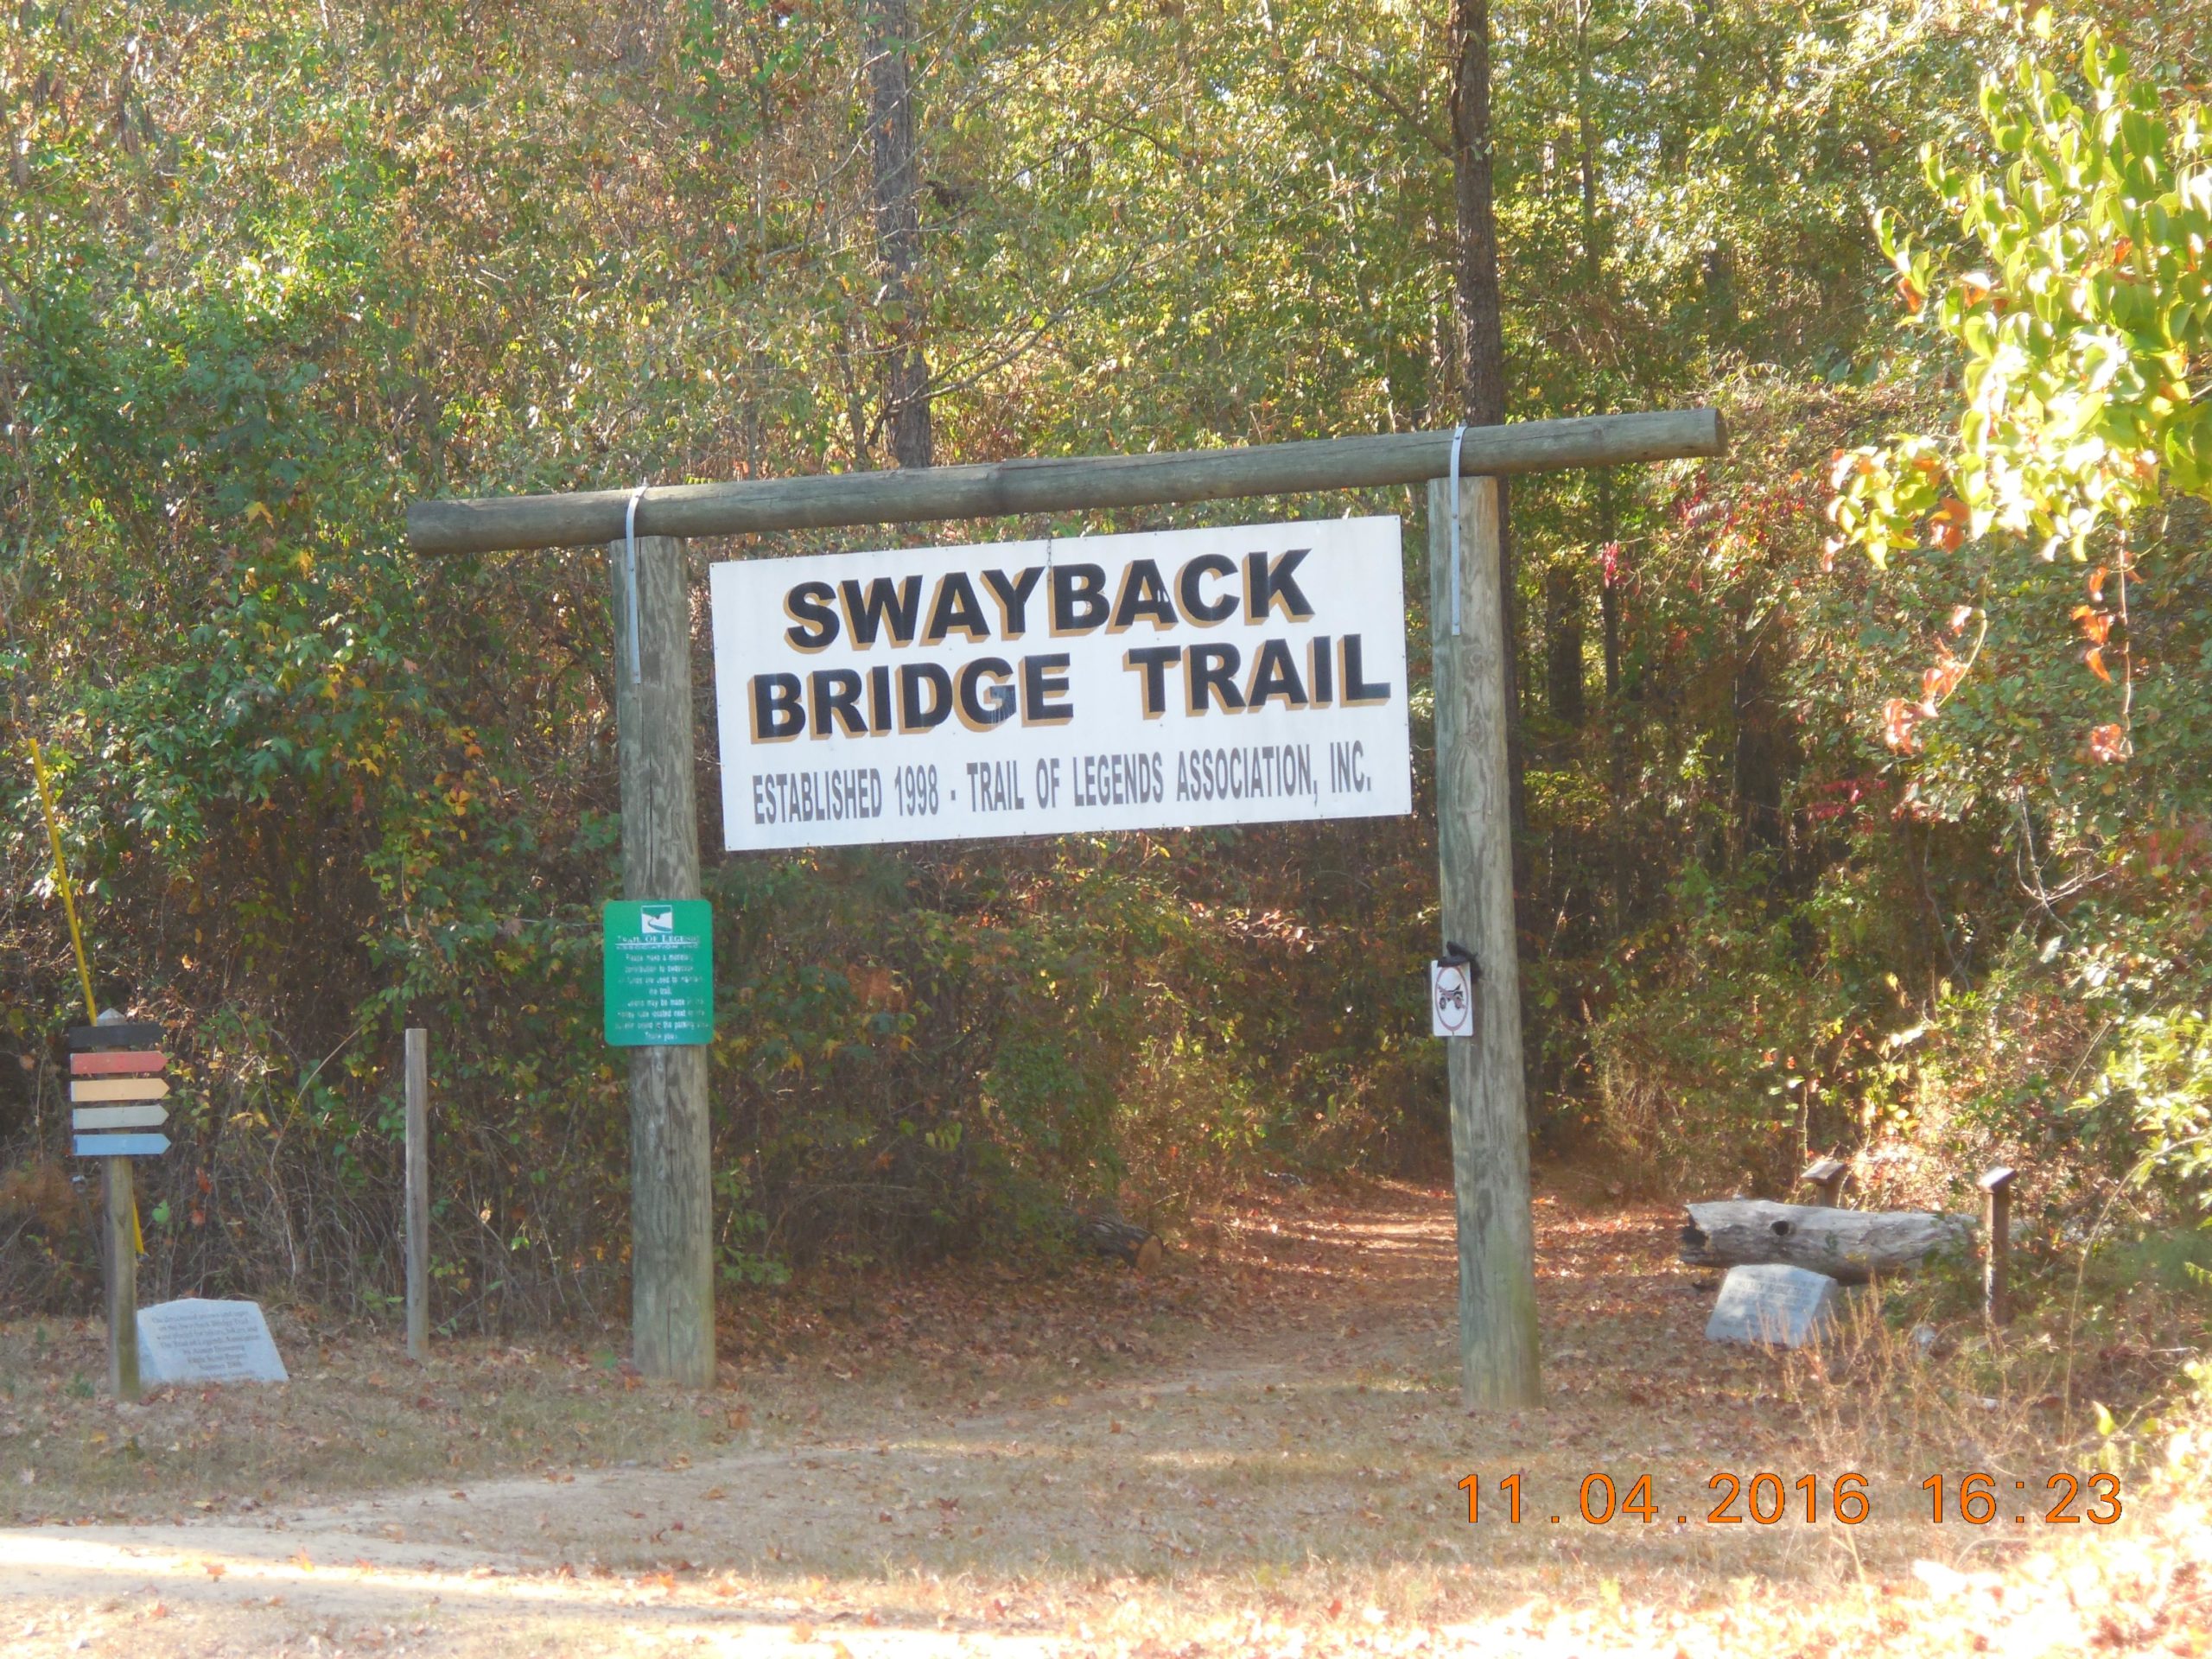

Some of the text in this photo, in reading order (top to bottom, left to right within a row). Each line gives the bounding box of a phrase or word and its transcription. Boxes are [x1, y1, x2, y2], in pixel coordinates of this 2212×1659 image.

[784, 549, 1316, 654] SWAYBACK
[749, 633, 1392, 745] BRIDGE TRAIL
[753, 767, 882, 824] ESTABLISHED
[894, 764, 939, 817] 1998
[966, 760, 1025, 812] TRAIL
[1036, 758, 1060, 809] OF
[1072, 751, 1165, 807] LEGENDS
[1176, 744, 1319, 807] ASSOCIATION,
[1330, 740, 1372, 793] INC.
